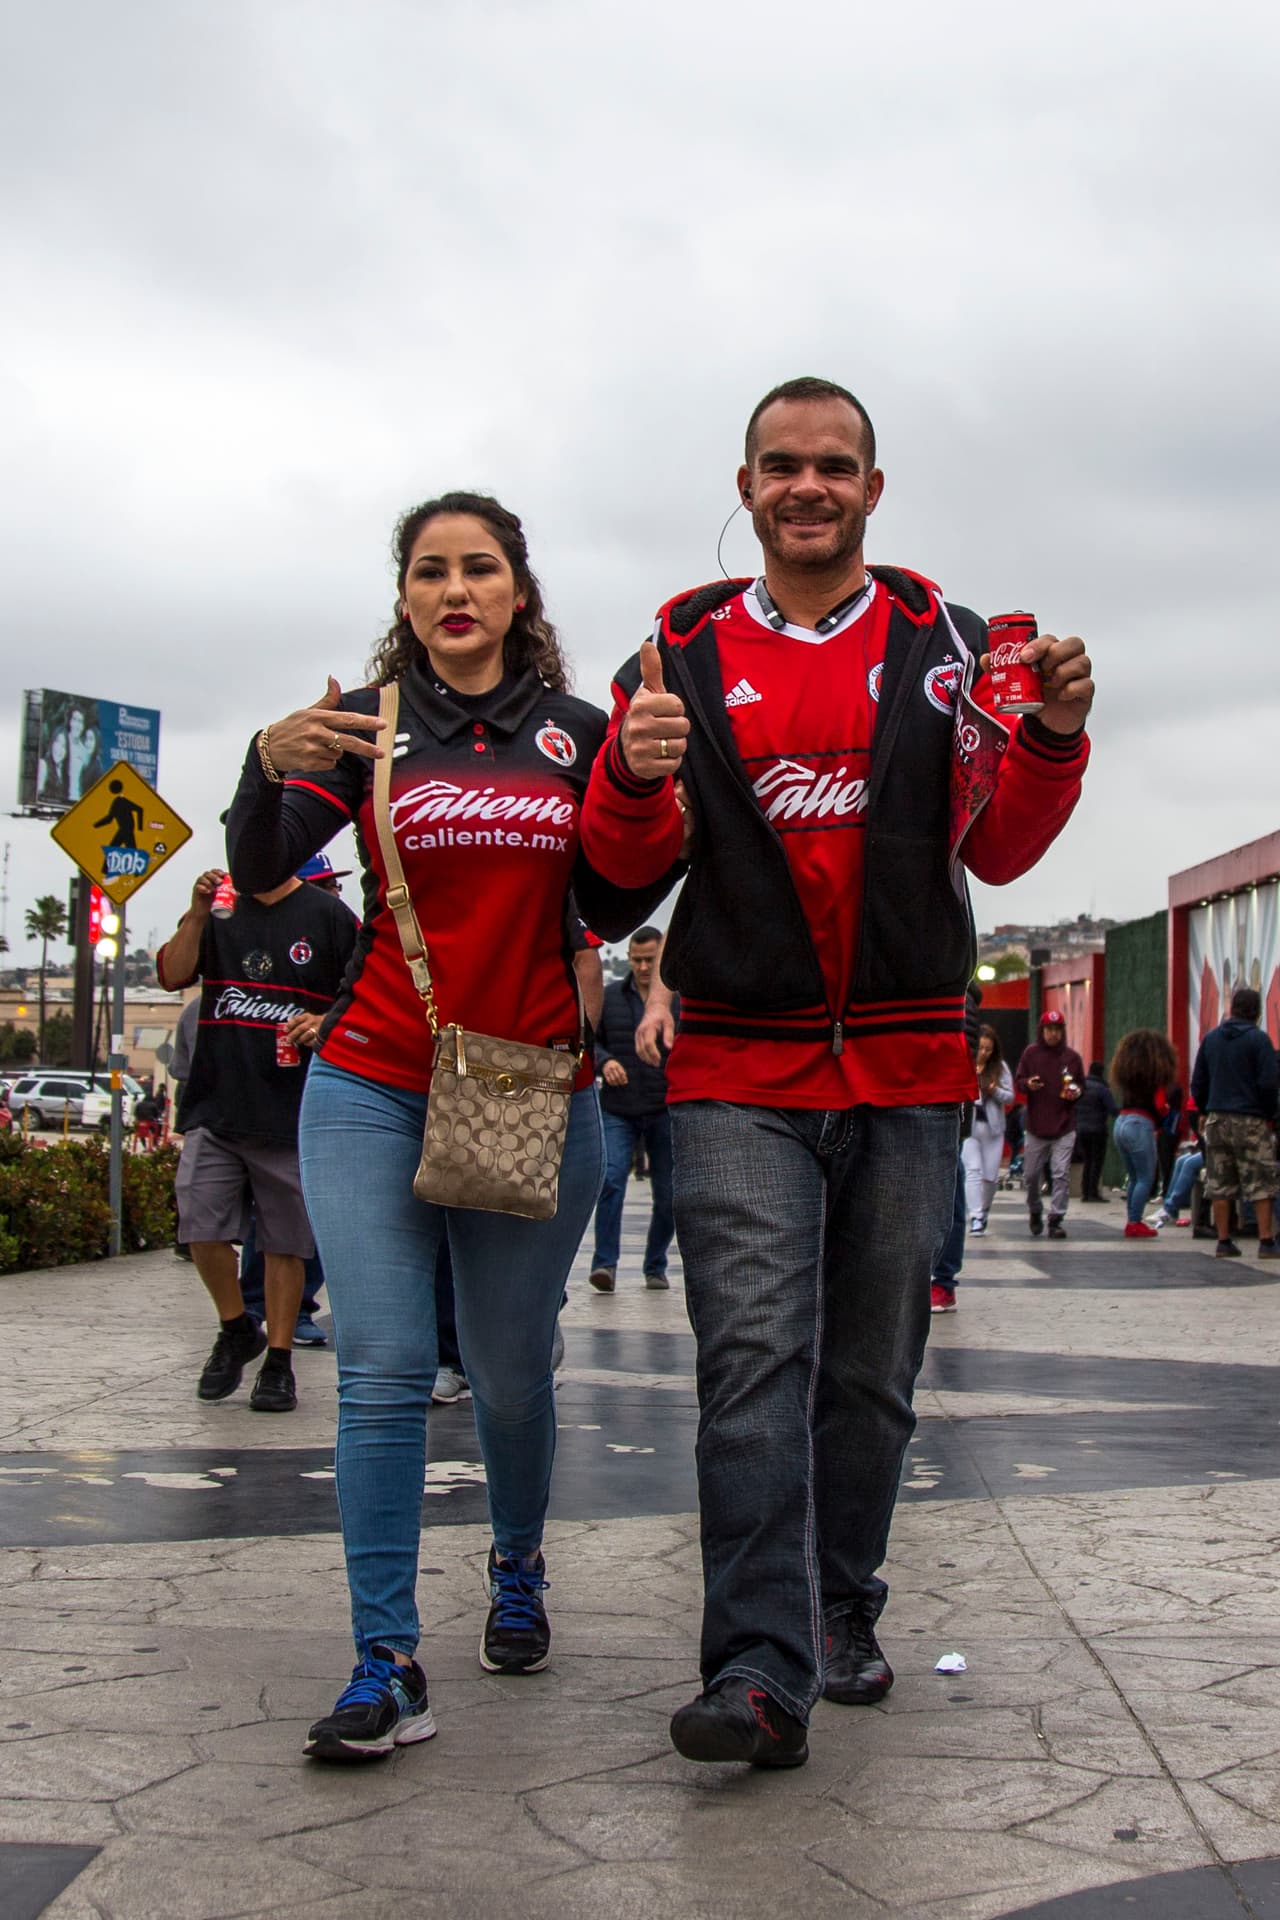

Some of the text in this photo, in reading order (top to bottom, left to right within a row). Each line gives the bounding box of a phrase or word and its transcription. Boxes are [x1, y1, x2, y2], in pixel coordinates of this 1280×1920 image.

[389, 779, 574, 833] Caliente
[404, 828, 568, 852] caliente.mx
[315, 851, 331, 869] T
